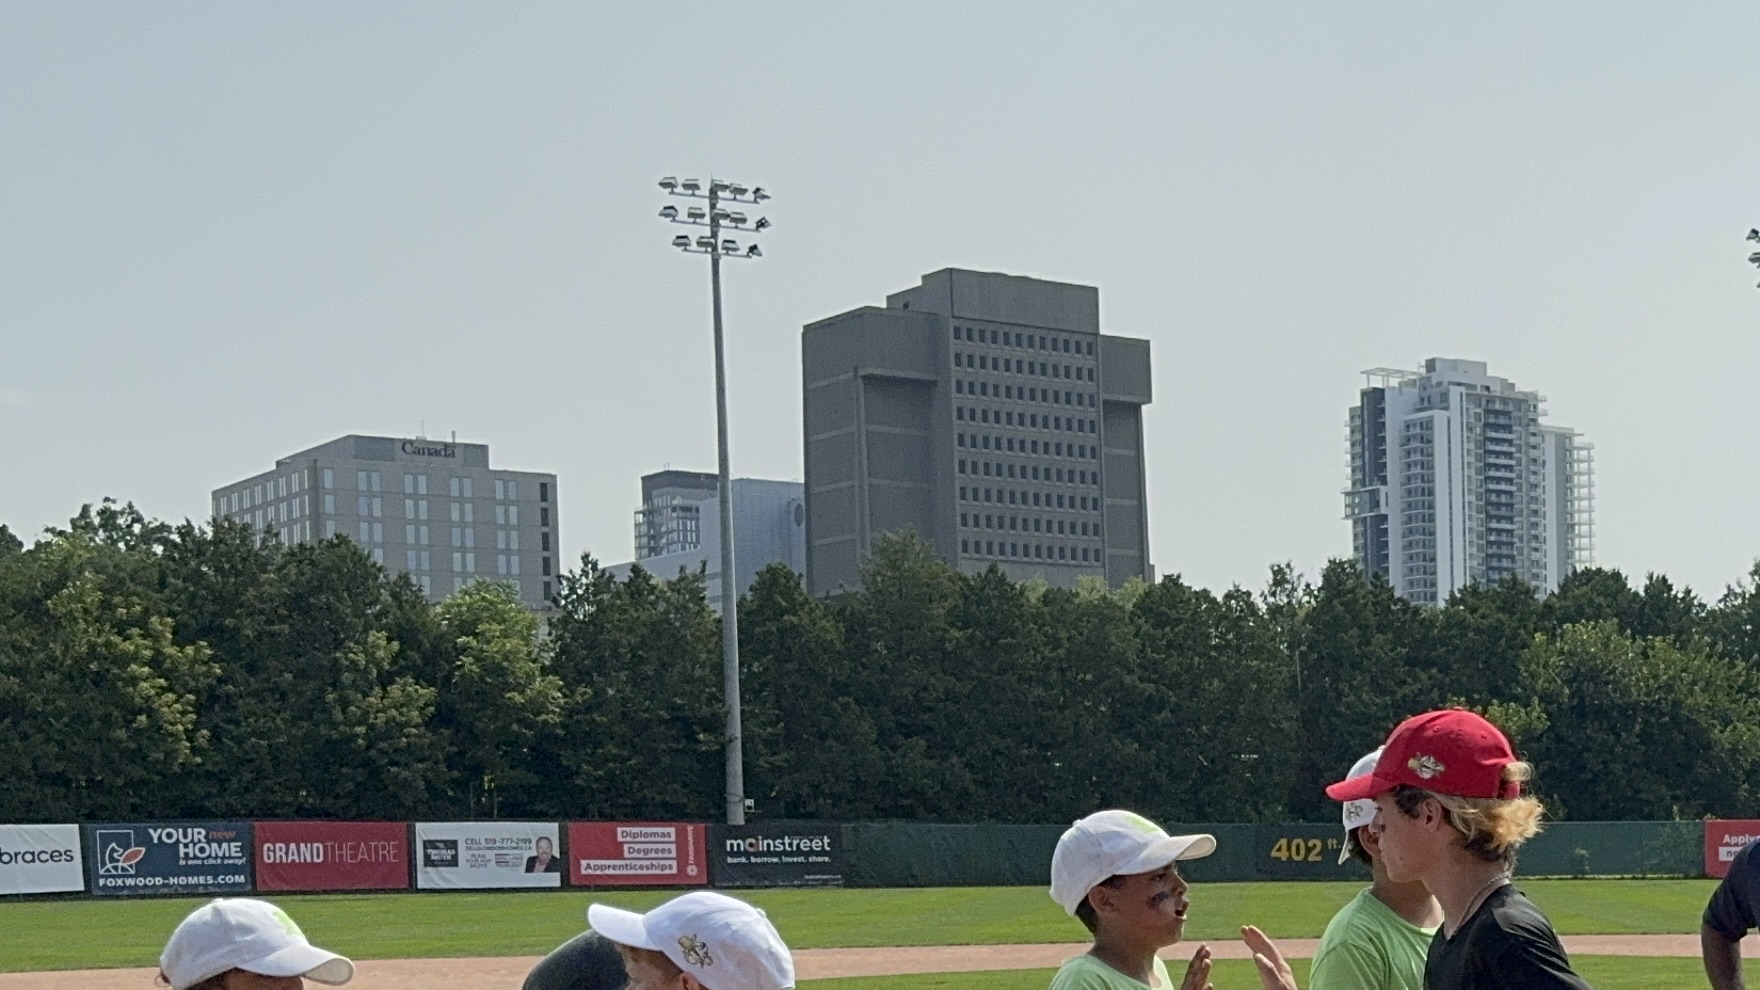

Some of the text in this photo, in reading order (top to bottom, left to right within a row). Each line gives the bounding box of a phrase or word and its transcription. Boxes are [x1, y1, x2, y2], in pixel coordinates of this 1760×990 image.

[401, 441, 456, 458] Canada
[148, 828, 236, 844] YOUR new
[621, 830, 672, 840] Diplomas
[179, 842, 243, 858] HOME
[726, 835, 831, 852] mainstreet
[1270, 838, 1341, 861] 402 ft.
[263, 841, 400, 864] GRAND THEATRE
[627, 847, 673, 858] Degrees
[584, 863, 674, 874] Apprenticeships
[99, 875, 245, 887] FOXWOOD-HOMES.COM
